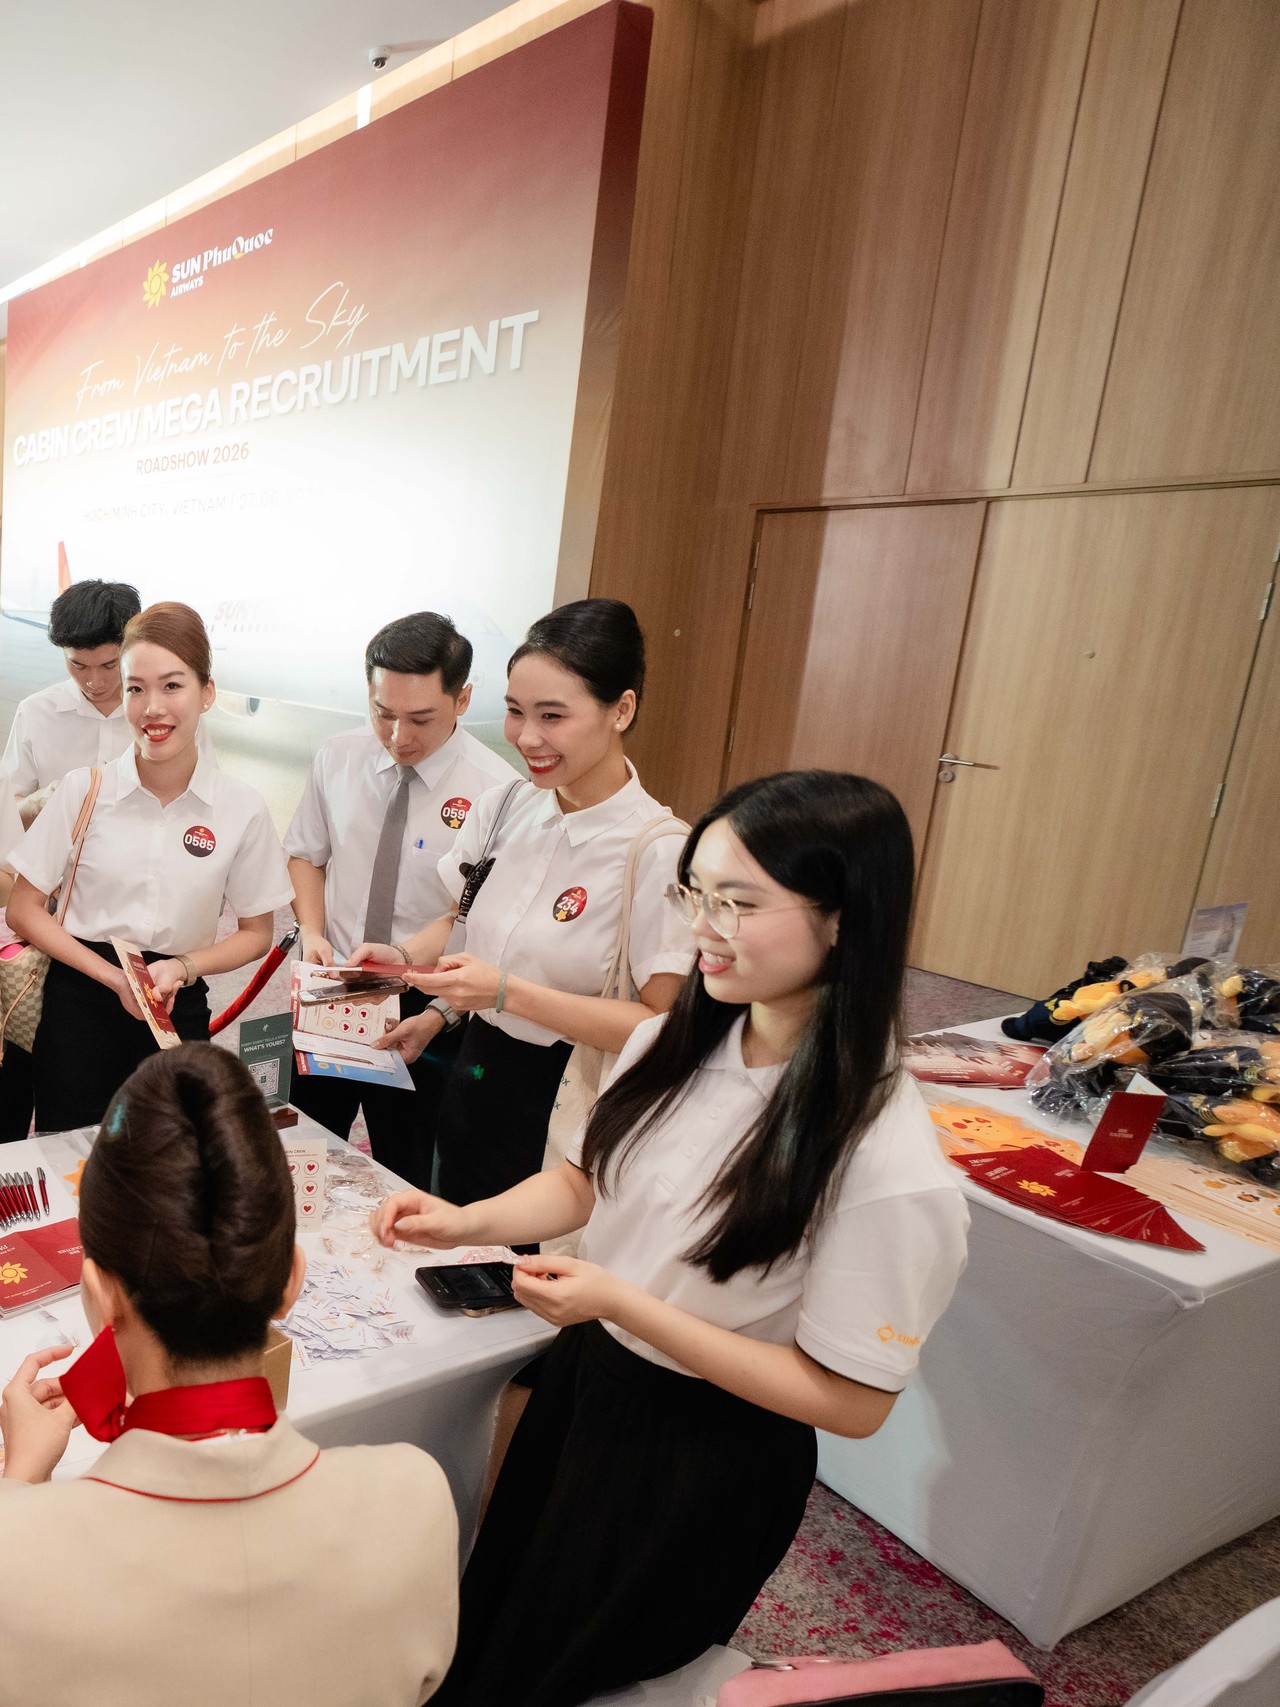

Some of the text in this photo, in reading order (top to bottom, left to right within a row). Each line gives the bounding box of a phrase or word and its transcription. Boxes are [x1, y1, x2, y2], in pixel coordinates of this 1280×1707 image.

[172, 228, 274, 284] SUN PhuQuoc
[170, 275, 204, 298] AIRWAYS
[76, 280, 370, 412] From Vietnam to the Sky
[13, 309, 540, 467] CABIN CREW MEGA RECRUITMENT
[136, 441, 250, 475] ROADSHOW 2026
[172, 495, 227, 516] VIETNAM
[442, 806, 467, 820] 059
[184, 833, 215, 851] 0585
[556, 896, 580, 915] 234
[243, 1038, 286, 1053] WHAT'S YOURS?
